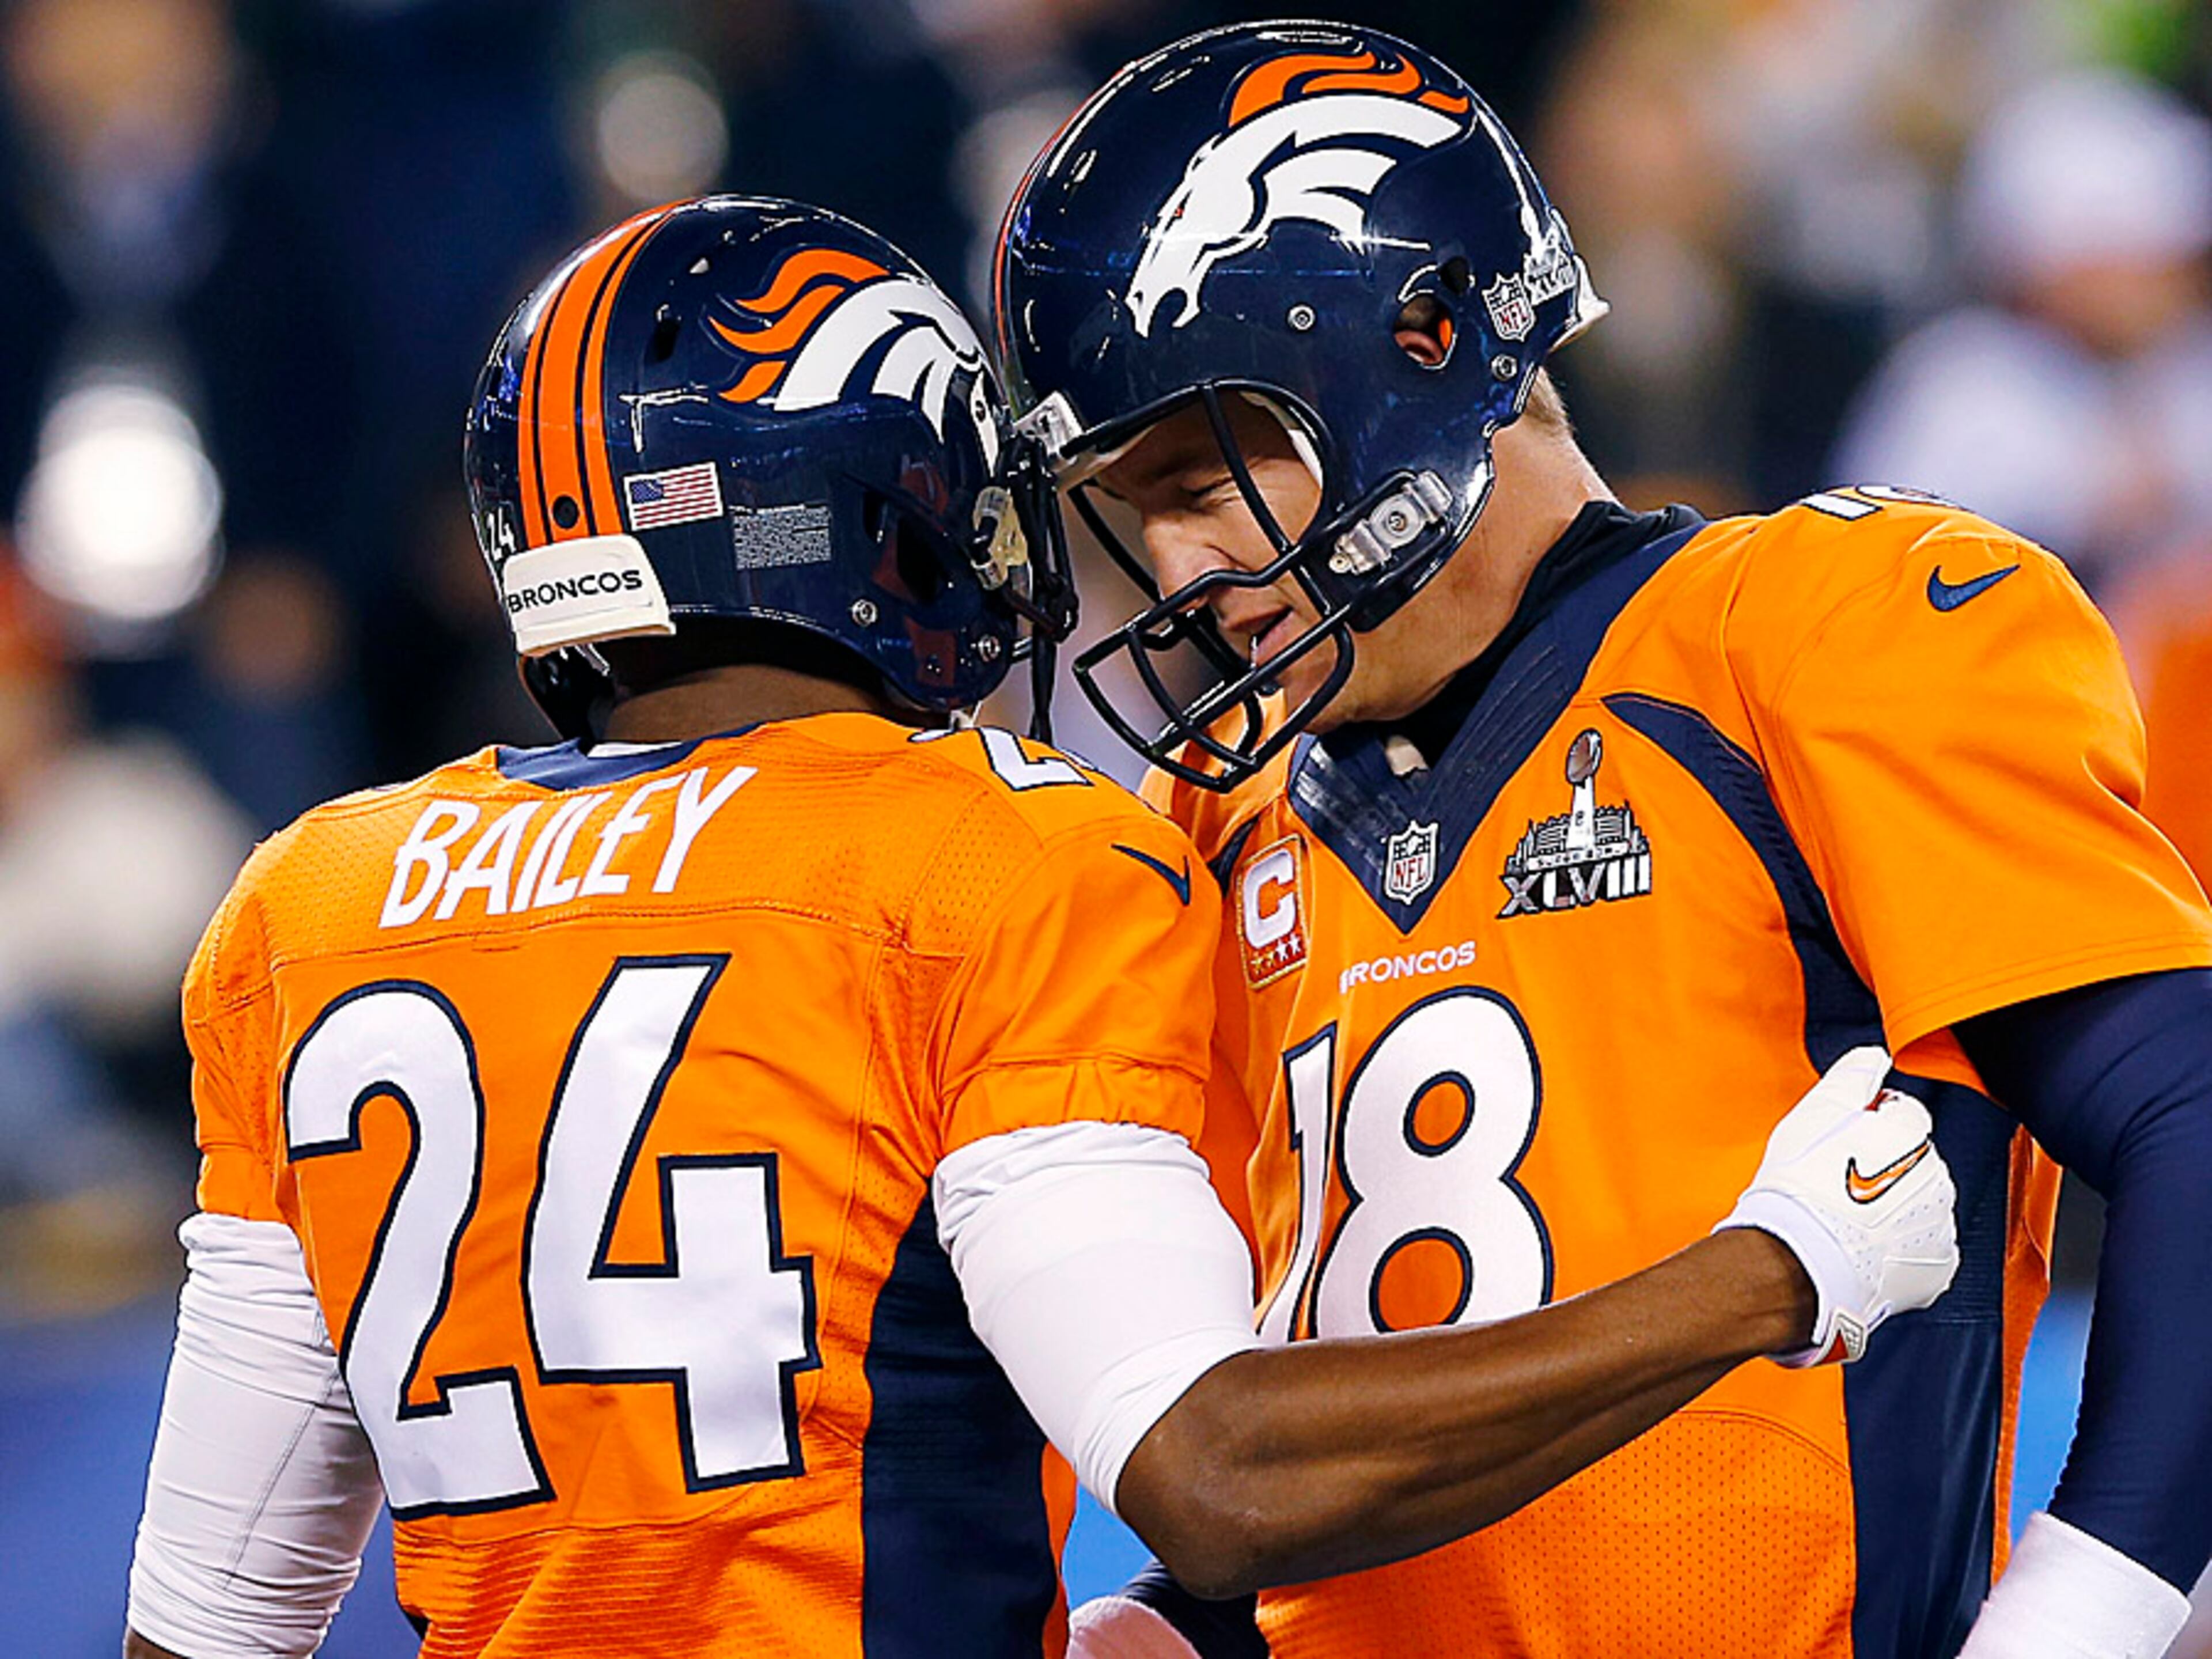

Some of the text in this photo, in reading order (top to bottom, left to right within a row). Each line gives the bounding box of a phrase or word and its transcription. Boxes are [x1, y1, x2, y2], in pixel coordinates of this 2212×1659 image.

[1497, 302, 1530, 333] NFL
[507, 569, 643, 614] BRONCOS
[378, 766, 758, 929] BAILEY
[1392, 856, 1429, 889] NFL
[1495, 853, 1652, 919] XLVIII
[1243, 848, 1297, 949] C
[1256, 985, 1556, 1345] 18
[284, 953, 823, 1521] 24
